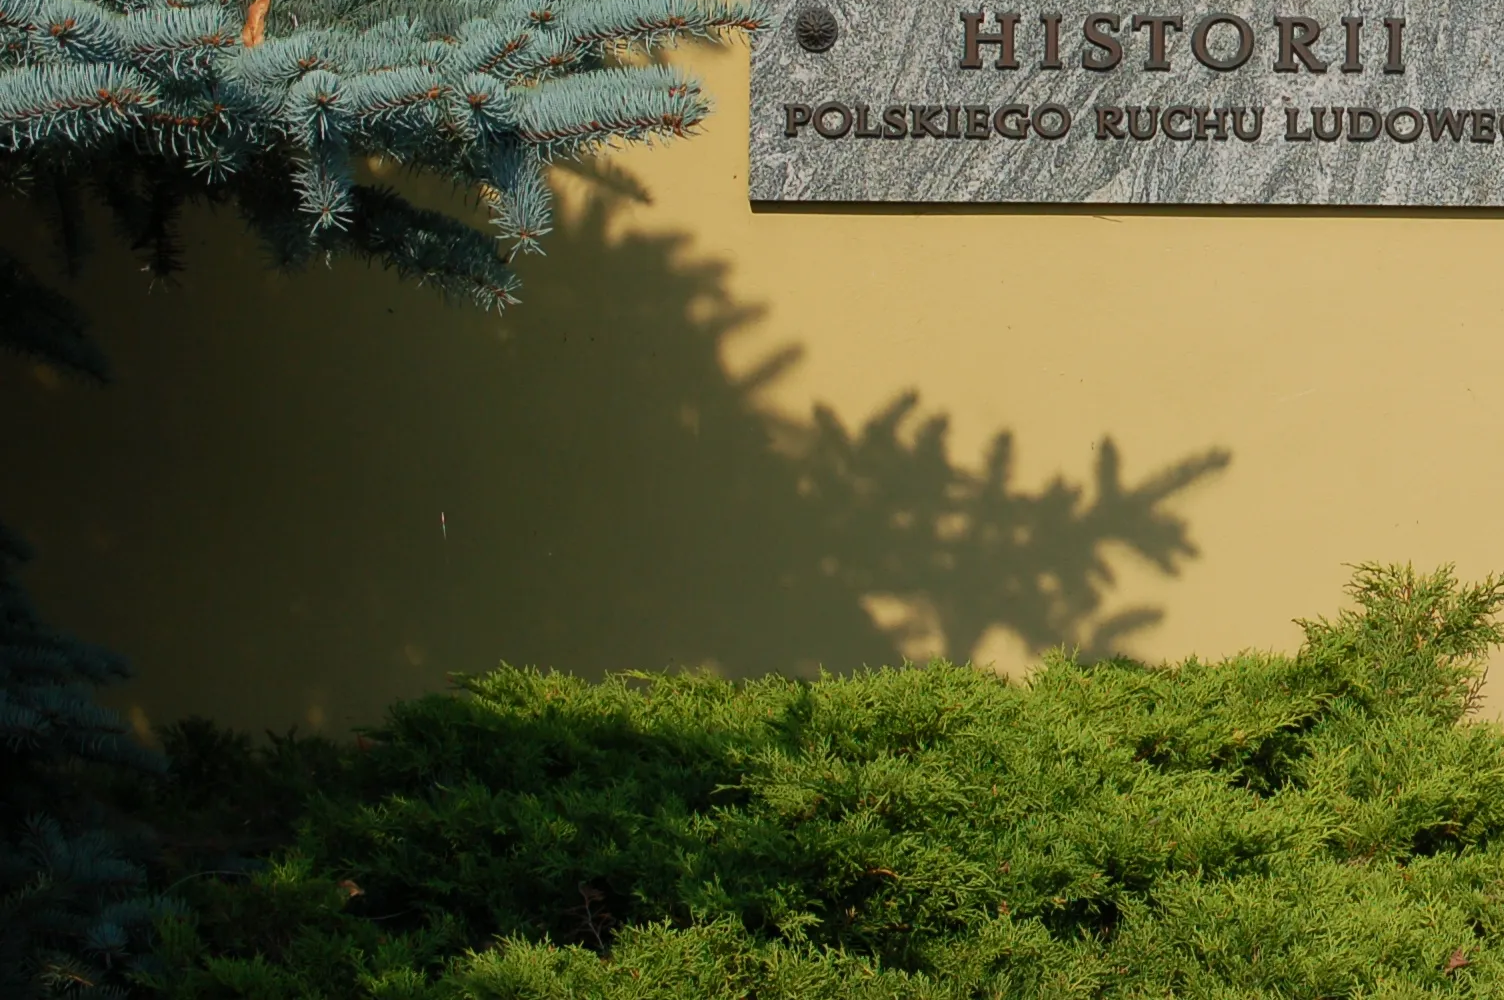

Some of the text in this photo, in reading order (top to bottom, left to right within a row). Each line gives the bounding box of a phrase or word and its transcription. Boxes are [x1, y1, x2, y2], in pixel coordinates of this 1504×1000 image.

[959, 11, 1406, 74] HISTORII
[783, 101, 1072, 140] POLSKIEGO
[1094, 103, 1265, 142] RUCHU
